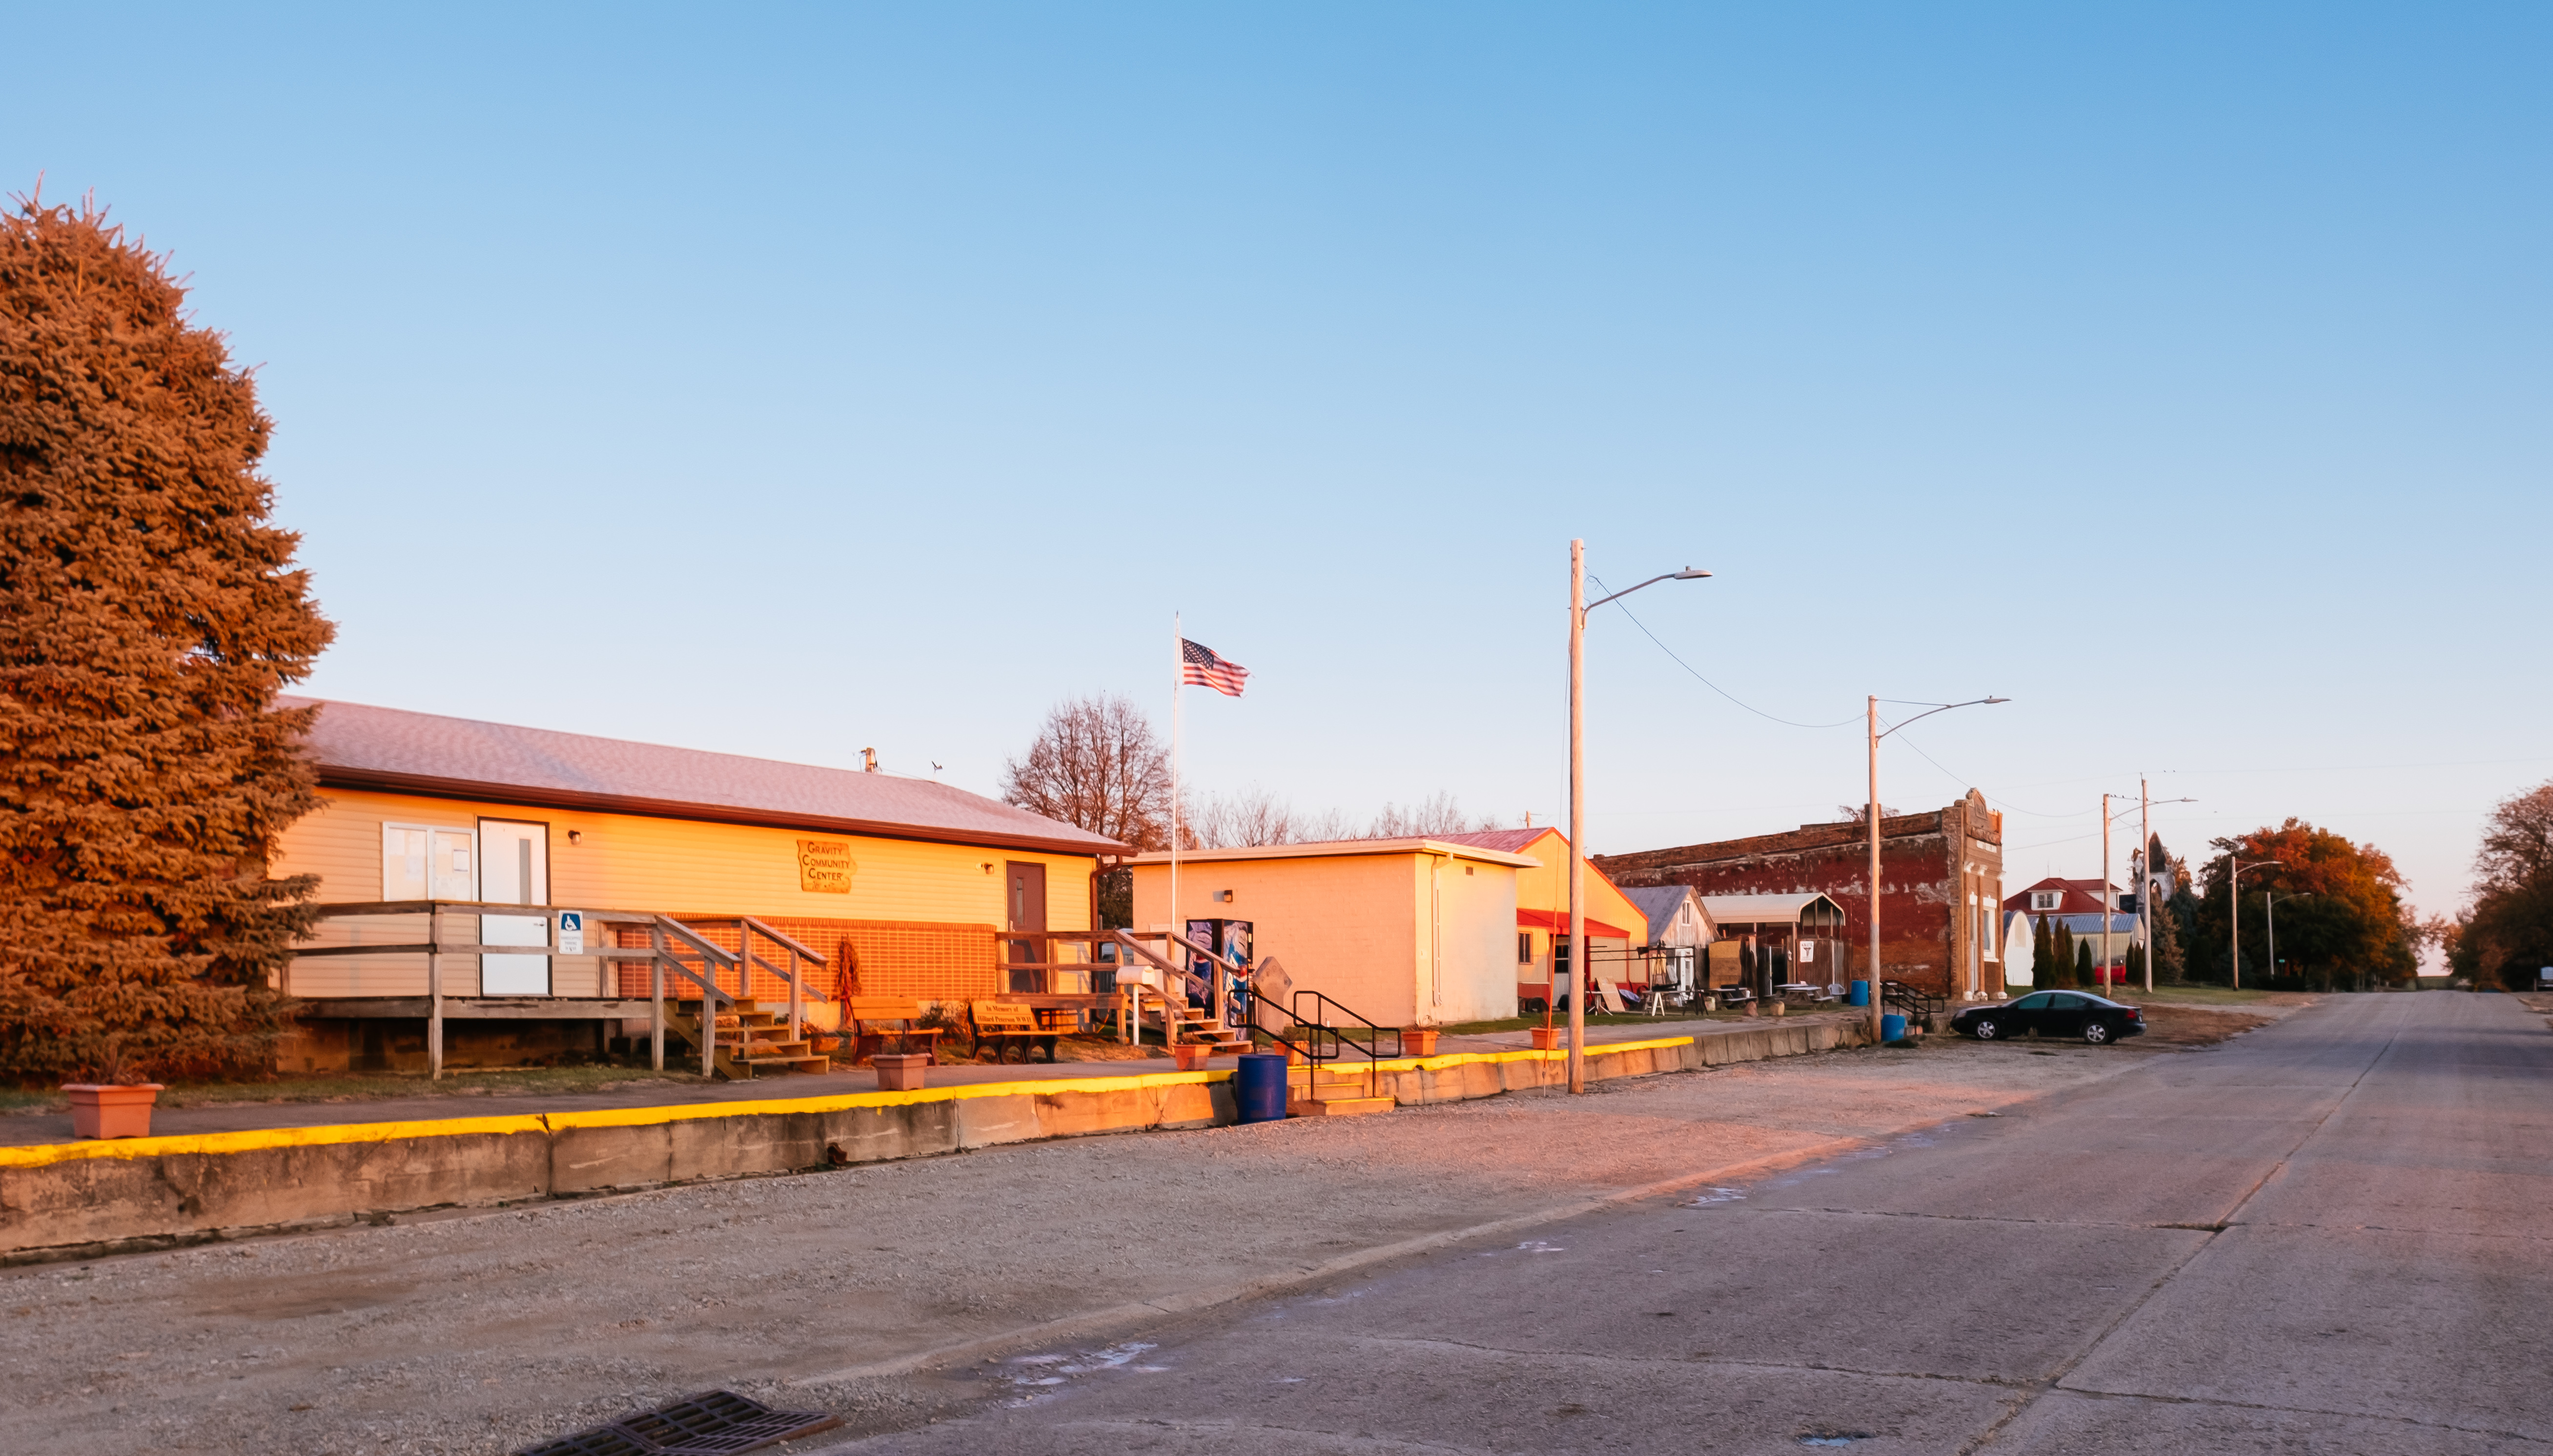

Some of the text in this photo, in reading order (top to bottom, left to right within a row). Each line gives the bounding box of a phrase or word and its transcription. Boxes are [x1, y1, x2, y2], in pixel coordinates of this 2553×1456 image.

[808, 842, 842, 855] GRAVITY
[802, 855, 850, 869] COMMUNITY
[809, 868, 843, 881] CENTER
[993, 1005, 1012, 1013] Memory
